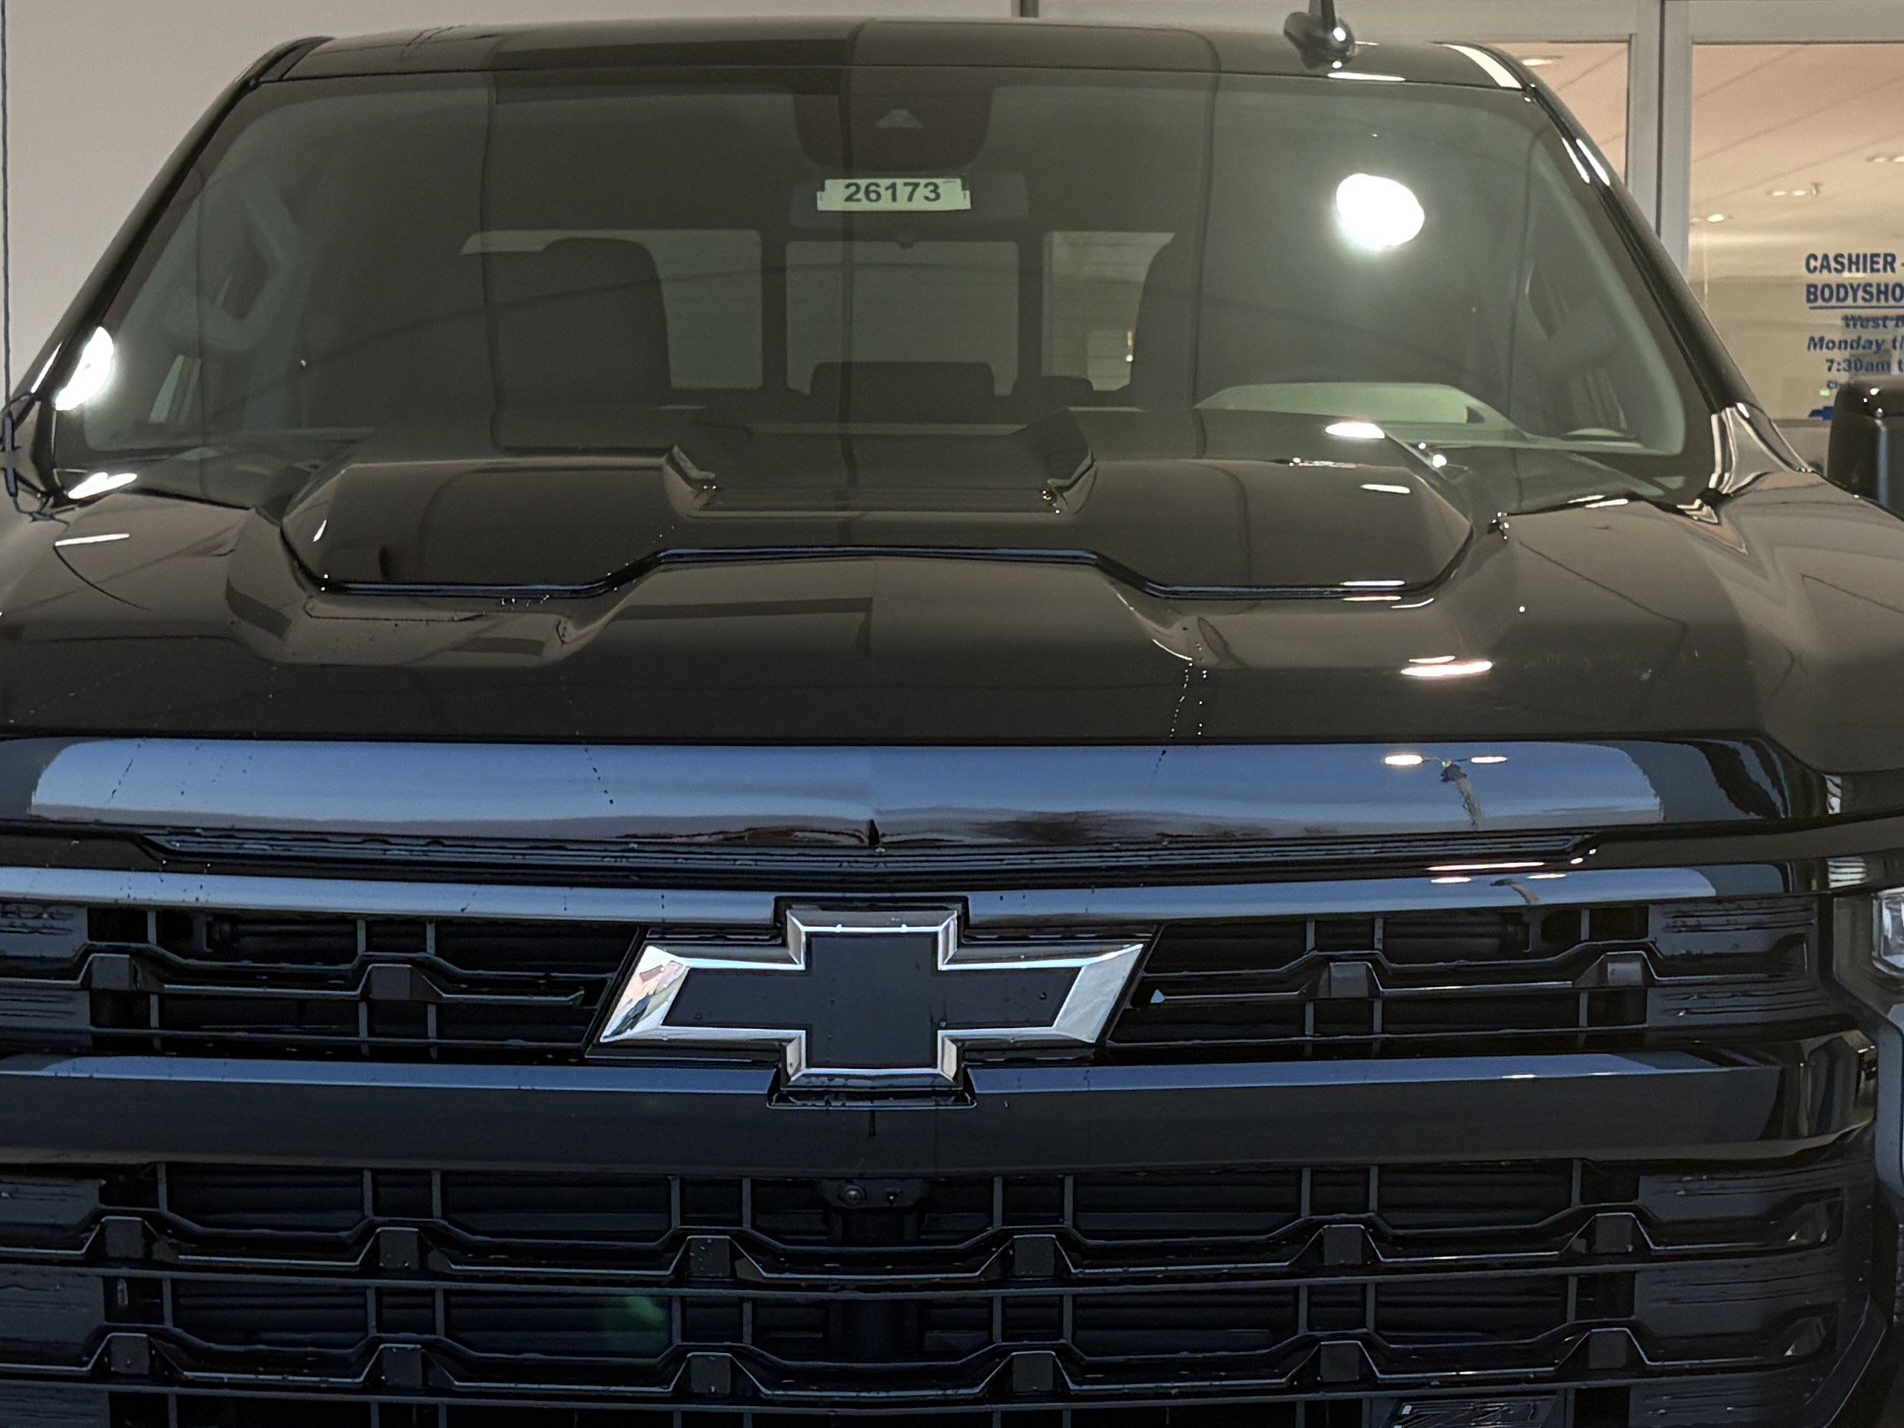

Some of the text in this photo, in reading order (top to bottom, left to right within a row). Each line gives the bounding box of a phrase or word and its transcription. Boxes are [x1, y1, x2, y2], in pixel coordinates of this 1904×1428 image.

[844, 182, 942, 203] 26173
[1805, 252, 1897, 274] CASHIER
[1843, 315, 1889, 330] West
[1807, 336, 1886, 353] Monday
[1825, 358, 1892, 373] 7:30am
